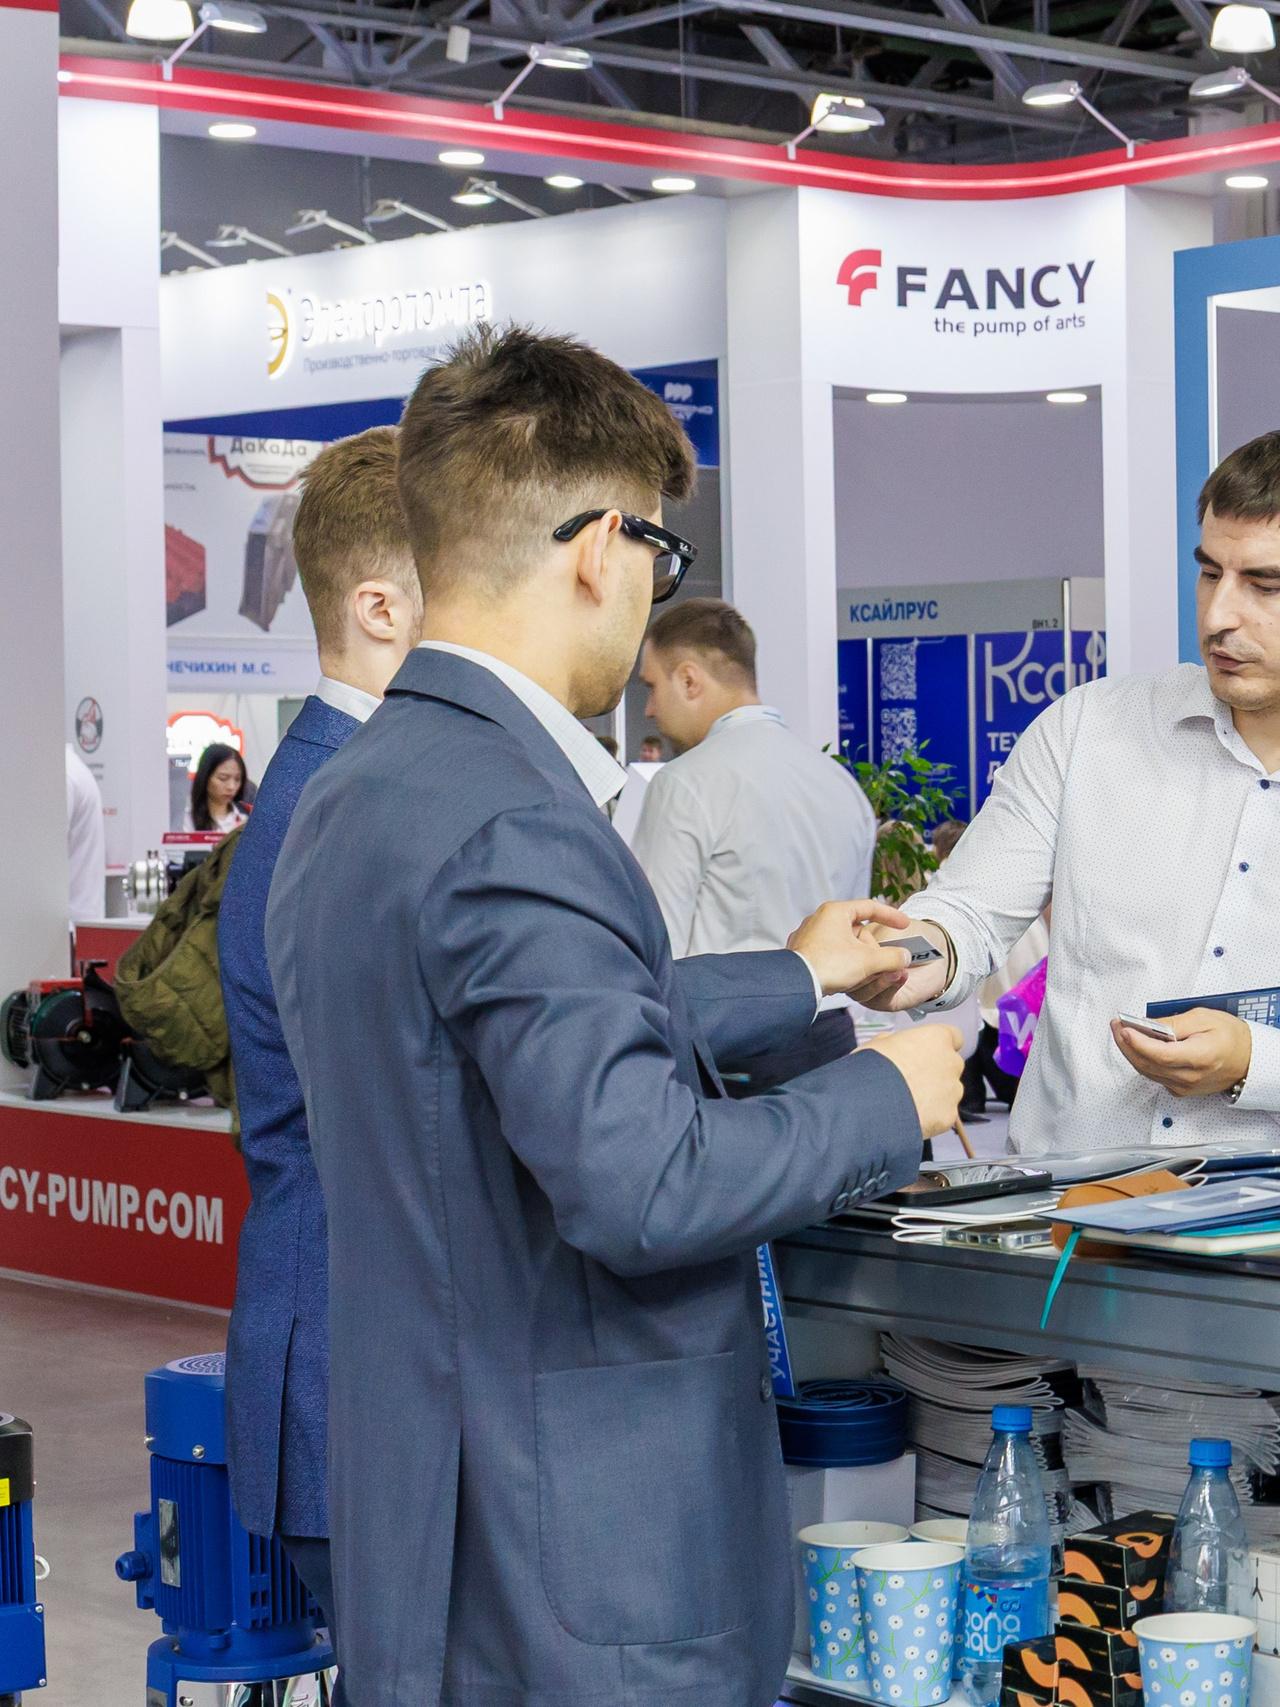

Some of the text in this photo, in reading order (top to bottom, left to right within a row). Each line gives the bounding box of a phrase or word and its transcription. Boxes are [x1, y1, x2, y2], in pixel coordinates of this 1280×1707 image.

[897, 259, 1095, 310] FANCY
[933, 313, 1086, 337] the pump of arts
[850, 598, 939, 622] КСАЙЛРУС
[0, 1166, 223, 1245] CY-PUMP.COM
